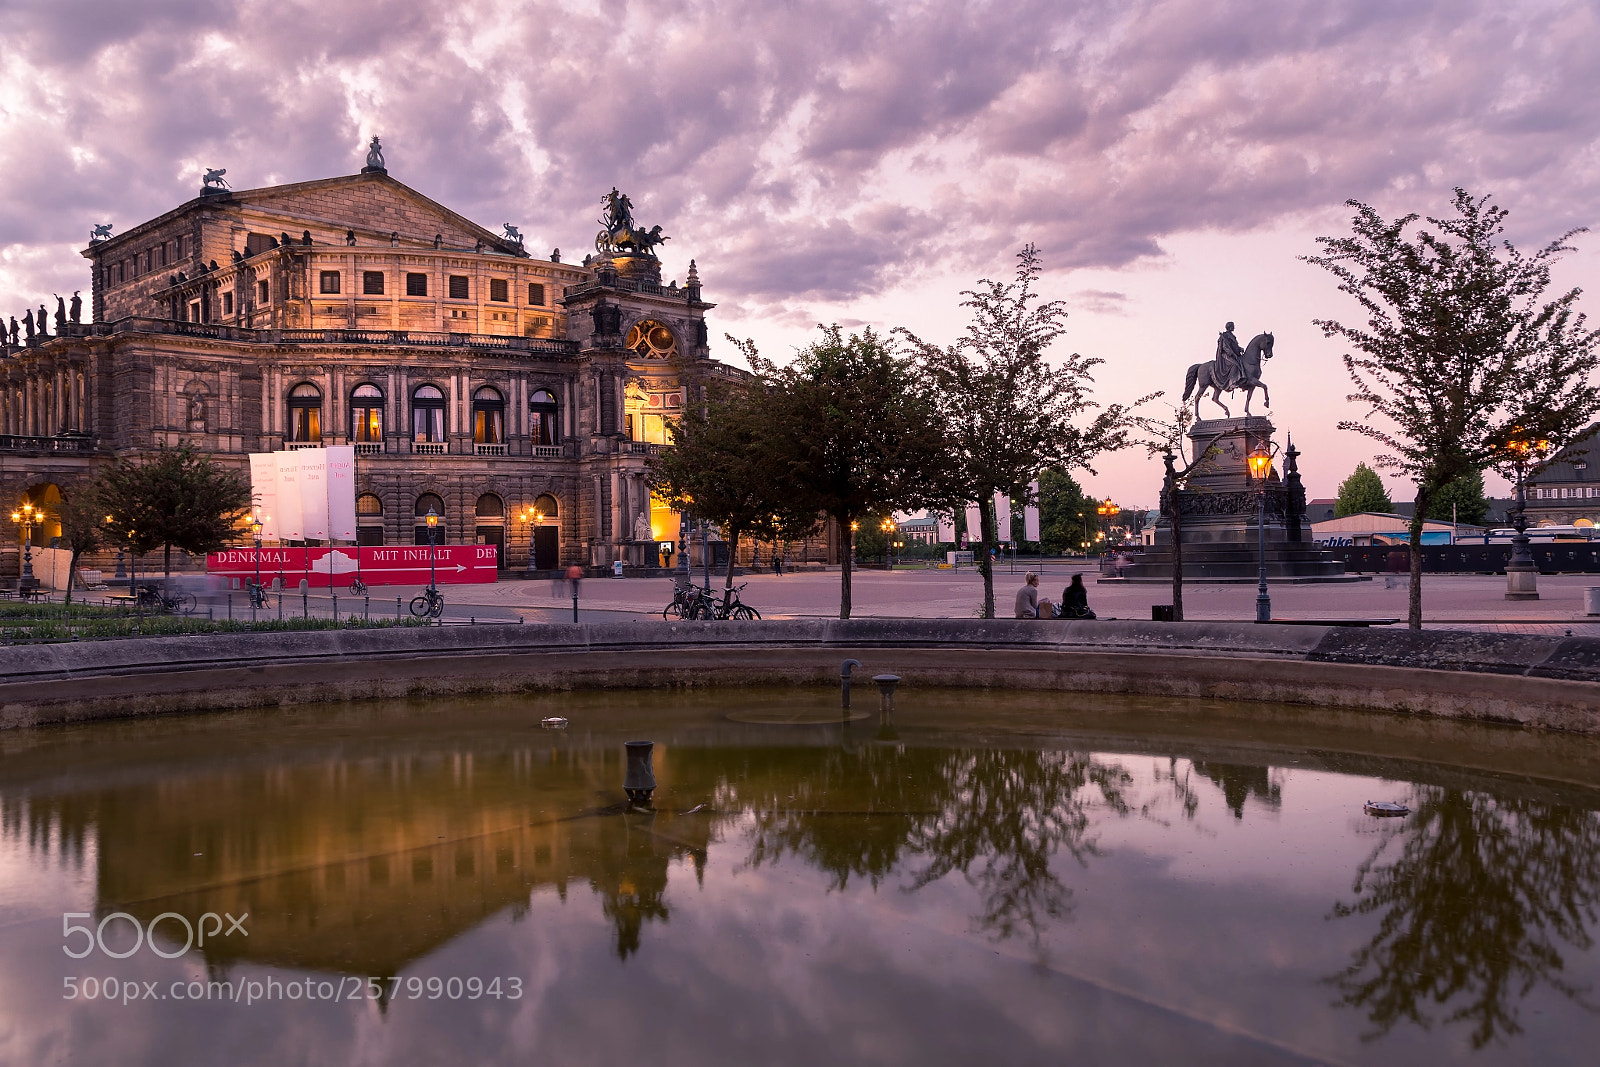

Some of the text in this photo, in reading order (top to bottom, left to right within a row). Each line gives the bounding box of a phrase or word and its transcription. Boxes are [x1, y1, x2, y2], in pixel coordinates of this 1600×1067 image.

[216, 551, 291, 563] DENKMAL
[373, 550, 399, 561] MIT
[403, 549, 452, 561] INHALT
